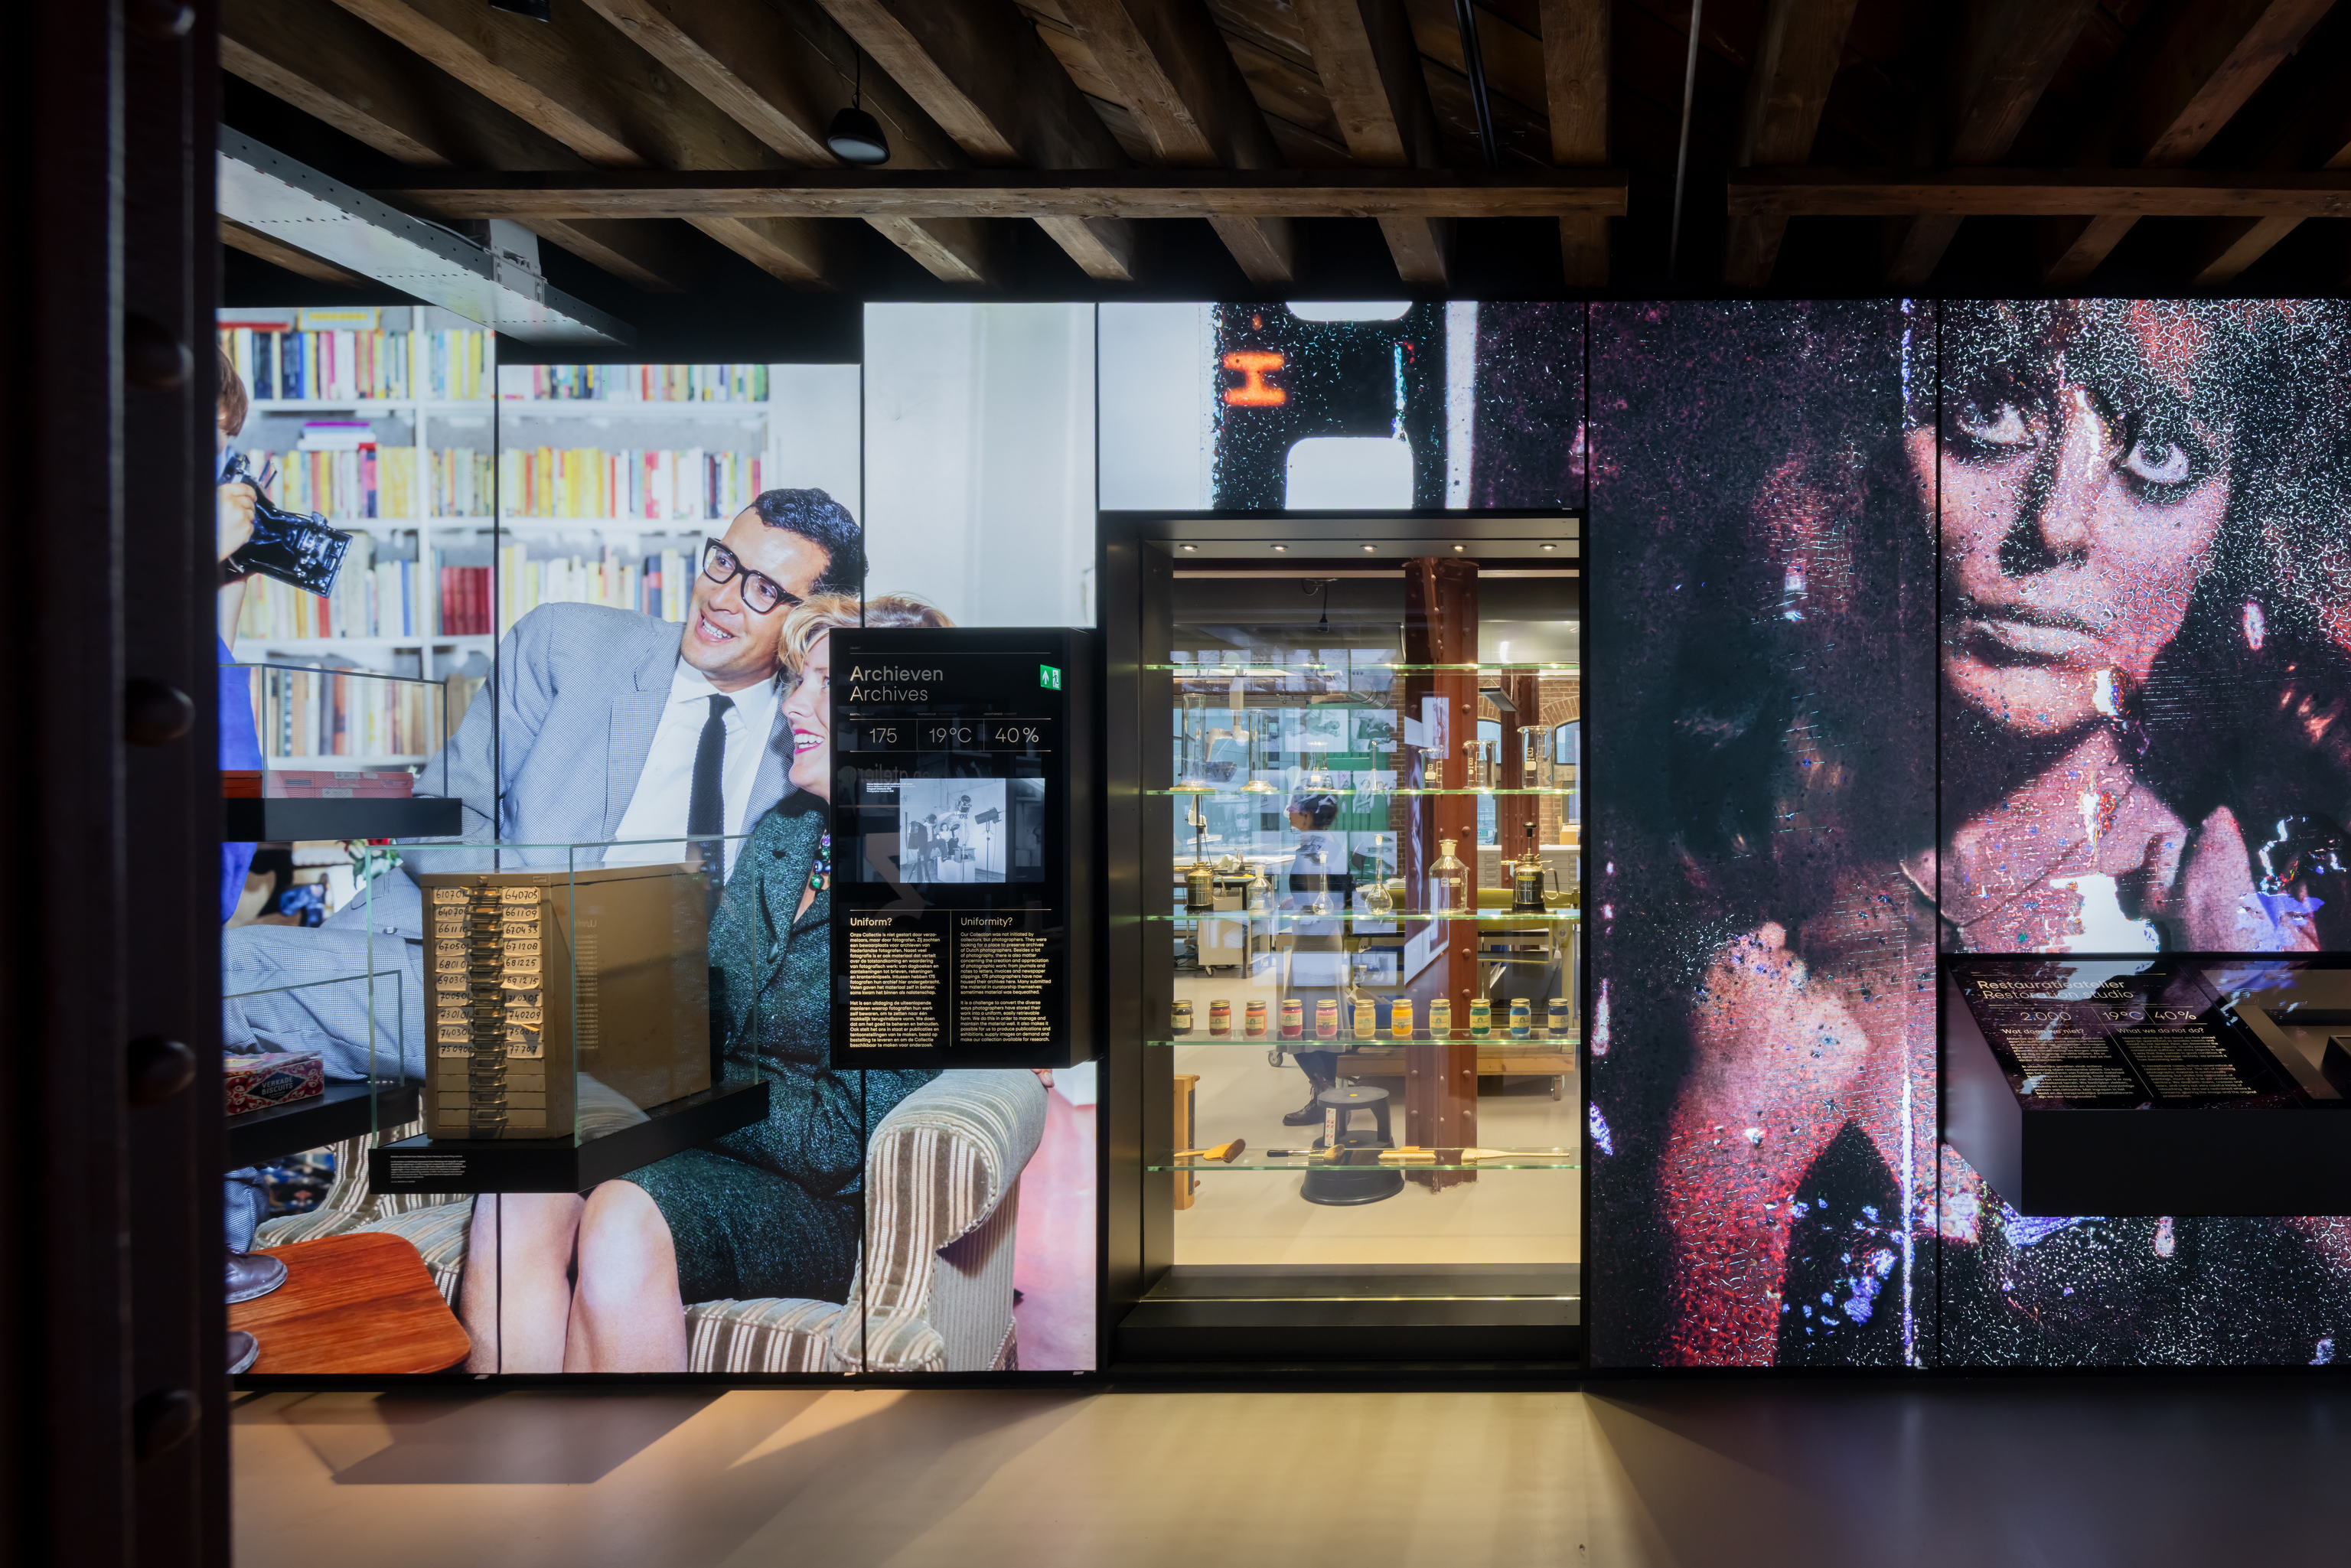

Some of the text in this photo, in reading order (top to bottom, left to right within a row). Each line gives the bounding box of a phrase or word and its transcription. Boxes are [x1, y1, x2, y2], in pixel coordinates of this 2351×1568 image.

[849, 665, 943, 681] Archieven
[849, 686, 928, 702] Archives
[869, 728, 897, 743] 175
[929, 728, 972, 743] 19°C
[995, 727, 1039, 743] 40%
[505, 888, 537, 900] 640705
[505, 907, 537, 918] 661109
[850, 918, 892, 926] Uniform?
[960, 917, 1013, 927] Uniformity?
[506, 924, 538, 934] 670433
[506, 940, 538, 950] 671208
[507, 976, 538, 985] 691215
[1977, 980, 2125, 989] Restauratieatelier
[1983, 990, 2134, 999] Restoration studio
[440, 1011, 469, 1019] 730101
[509, 1011, 541, 1020] 740209
[2020, 1012, 2071, 1021] 2.000
[2103, 1011, 2143, 1020] 19°C
[2155, 1011, 2196, 1020] 40%
[262, 1077, 293, 1088] VERKADE
[262, 1083, 293, 1095] BISCUITS
